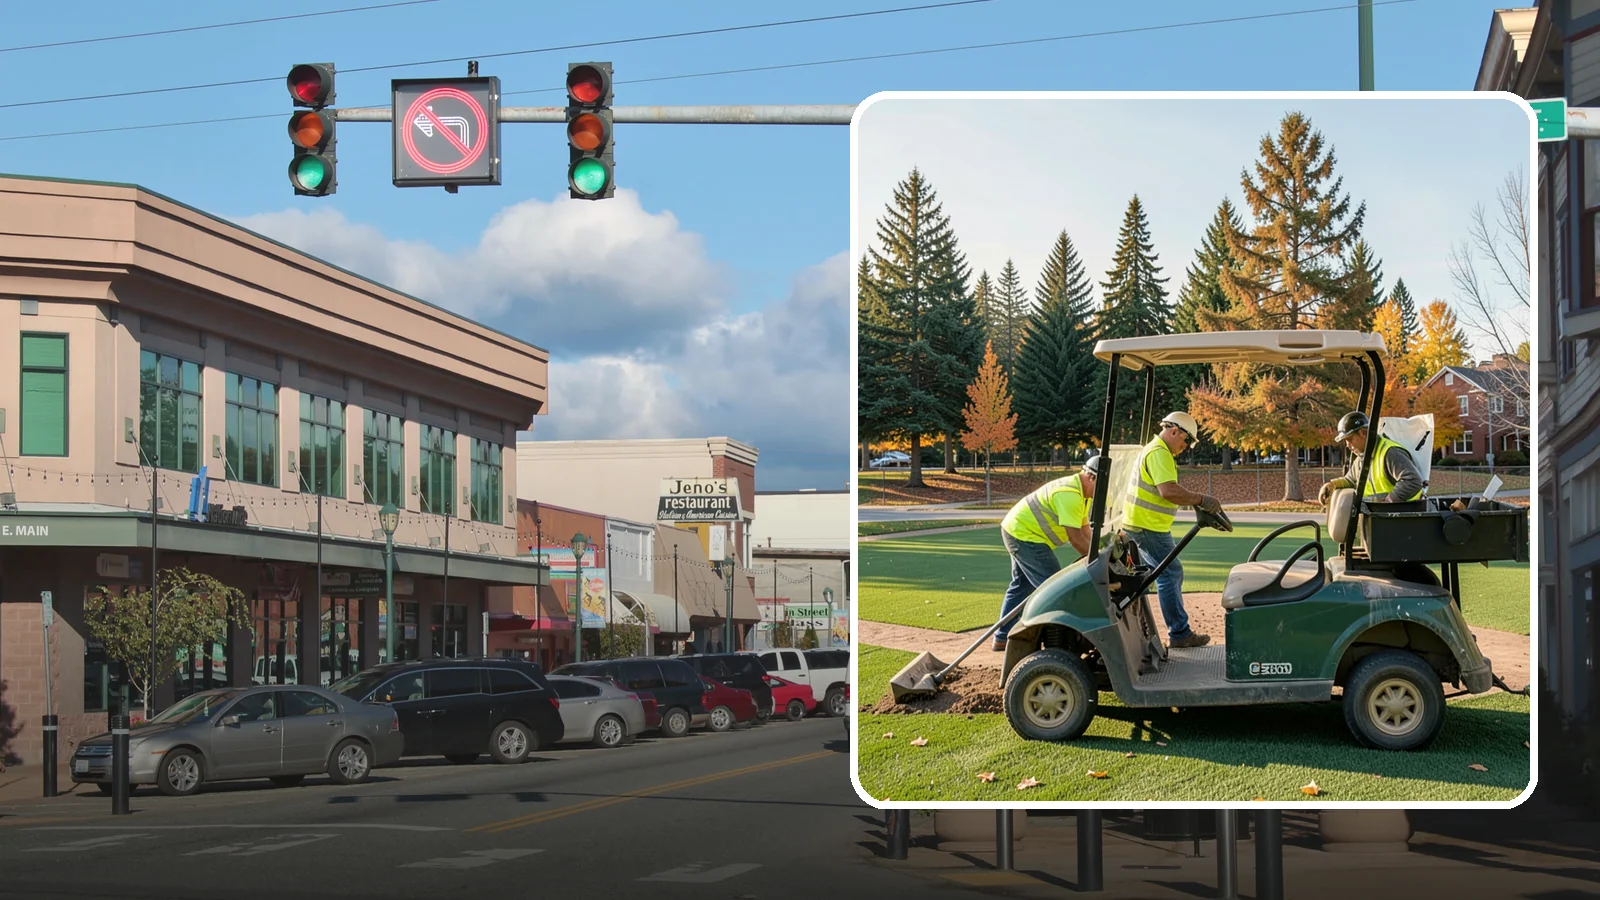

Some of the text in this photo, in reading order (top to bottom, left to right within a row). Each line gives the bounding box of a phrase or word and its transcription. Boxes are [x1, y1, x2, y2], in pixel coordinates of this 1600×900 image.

[670, 480, 728, 495] Jeno's
[665, 497, 731, 509] restaurant
[686, 509, 714, 519] American
[715, 509, 738, 519] Cuisine
[2, 525, 49, 536] E. MAIN
[797, 608, 828, 617] Street
[791, 619, 824, 627] lass
